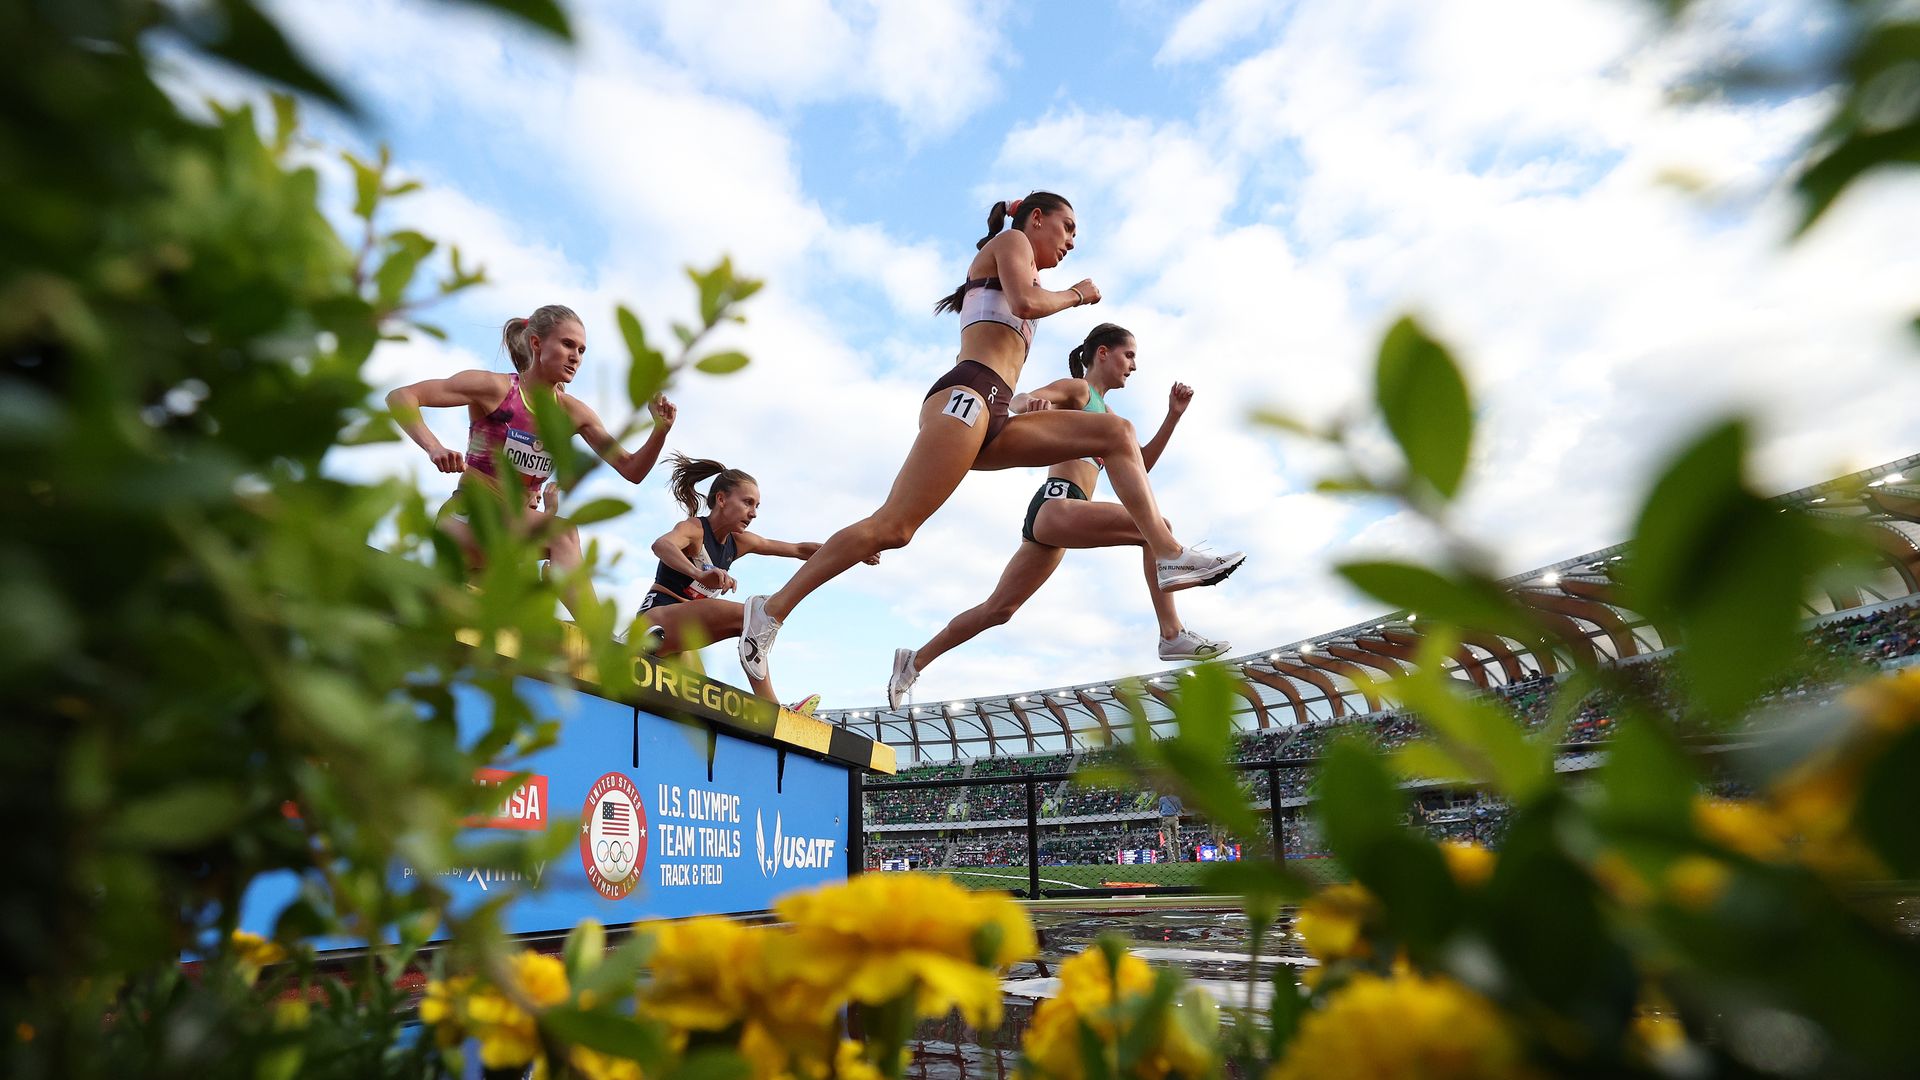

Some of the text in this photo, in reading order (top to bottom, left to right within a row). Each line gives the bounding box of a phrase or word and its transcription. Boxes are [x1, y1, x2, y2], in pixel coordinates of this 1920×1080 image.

[951, 393, 975, 418] 11
[631, 656, 760, 724] OREGON
[589, 775, 642, 810] UNITED STATES
[658, 783, 741, 823] U.S. OLYMPIC
[658, 824, 741, 858] TEAM TRIALS
[782, 836, 836, 869] USATF
[452, 866, 463, 879] by
[588, 865, 640, 896] OLYMPIC TEAM
[660, 864, 723, 886] TRACK & FIELD
